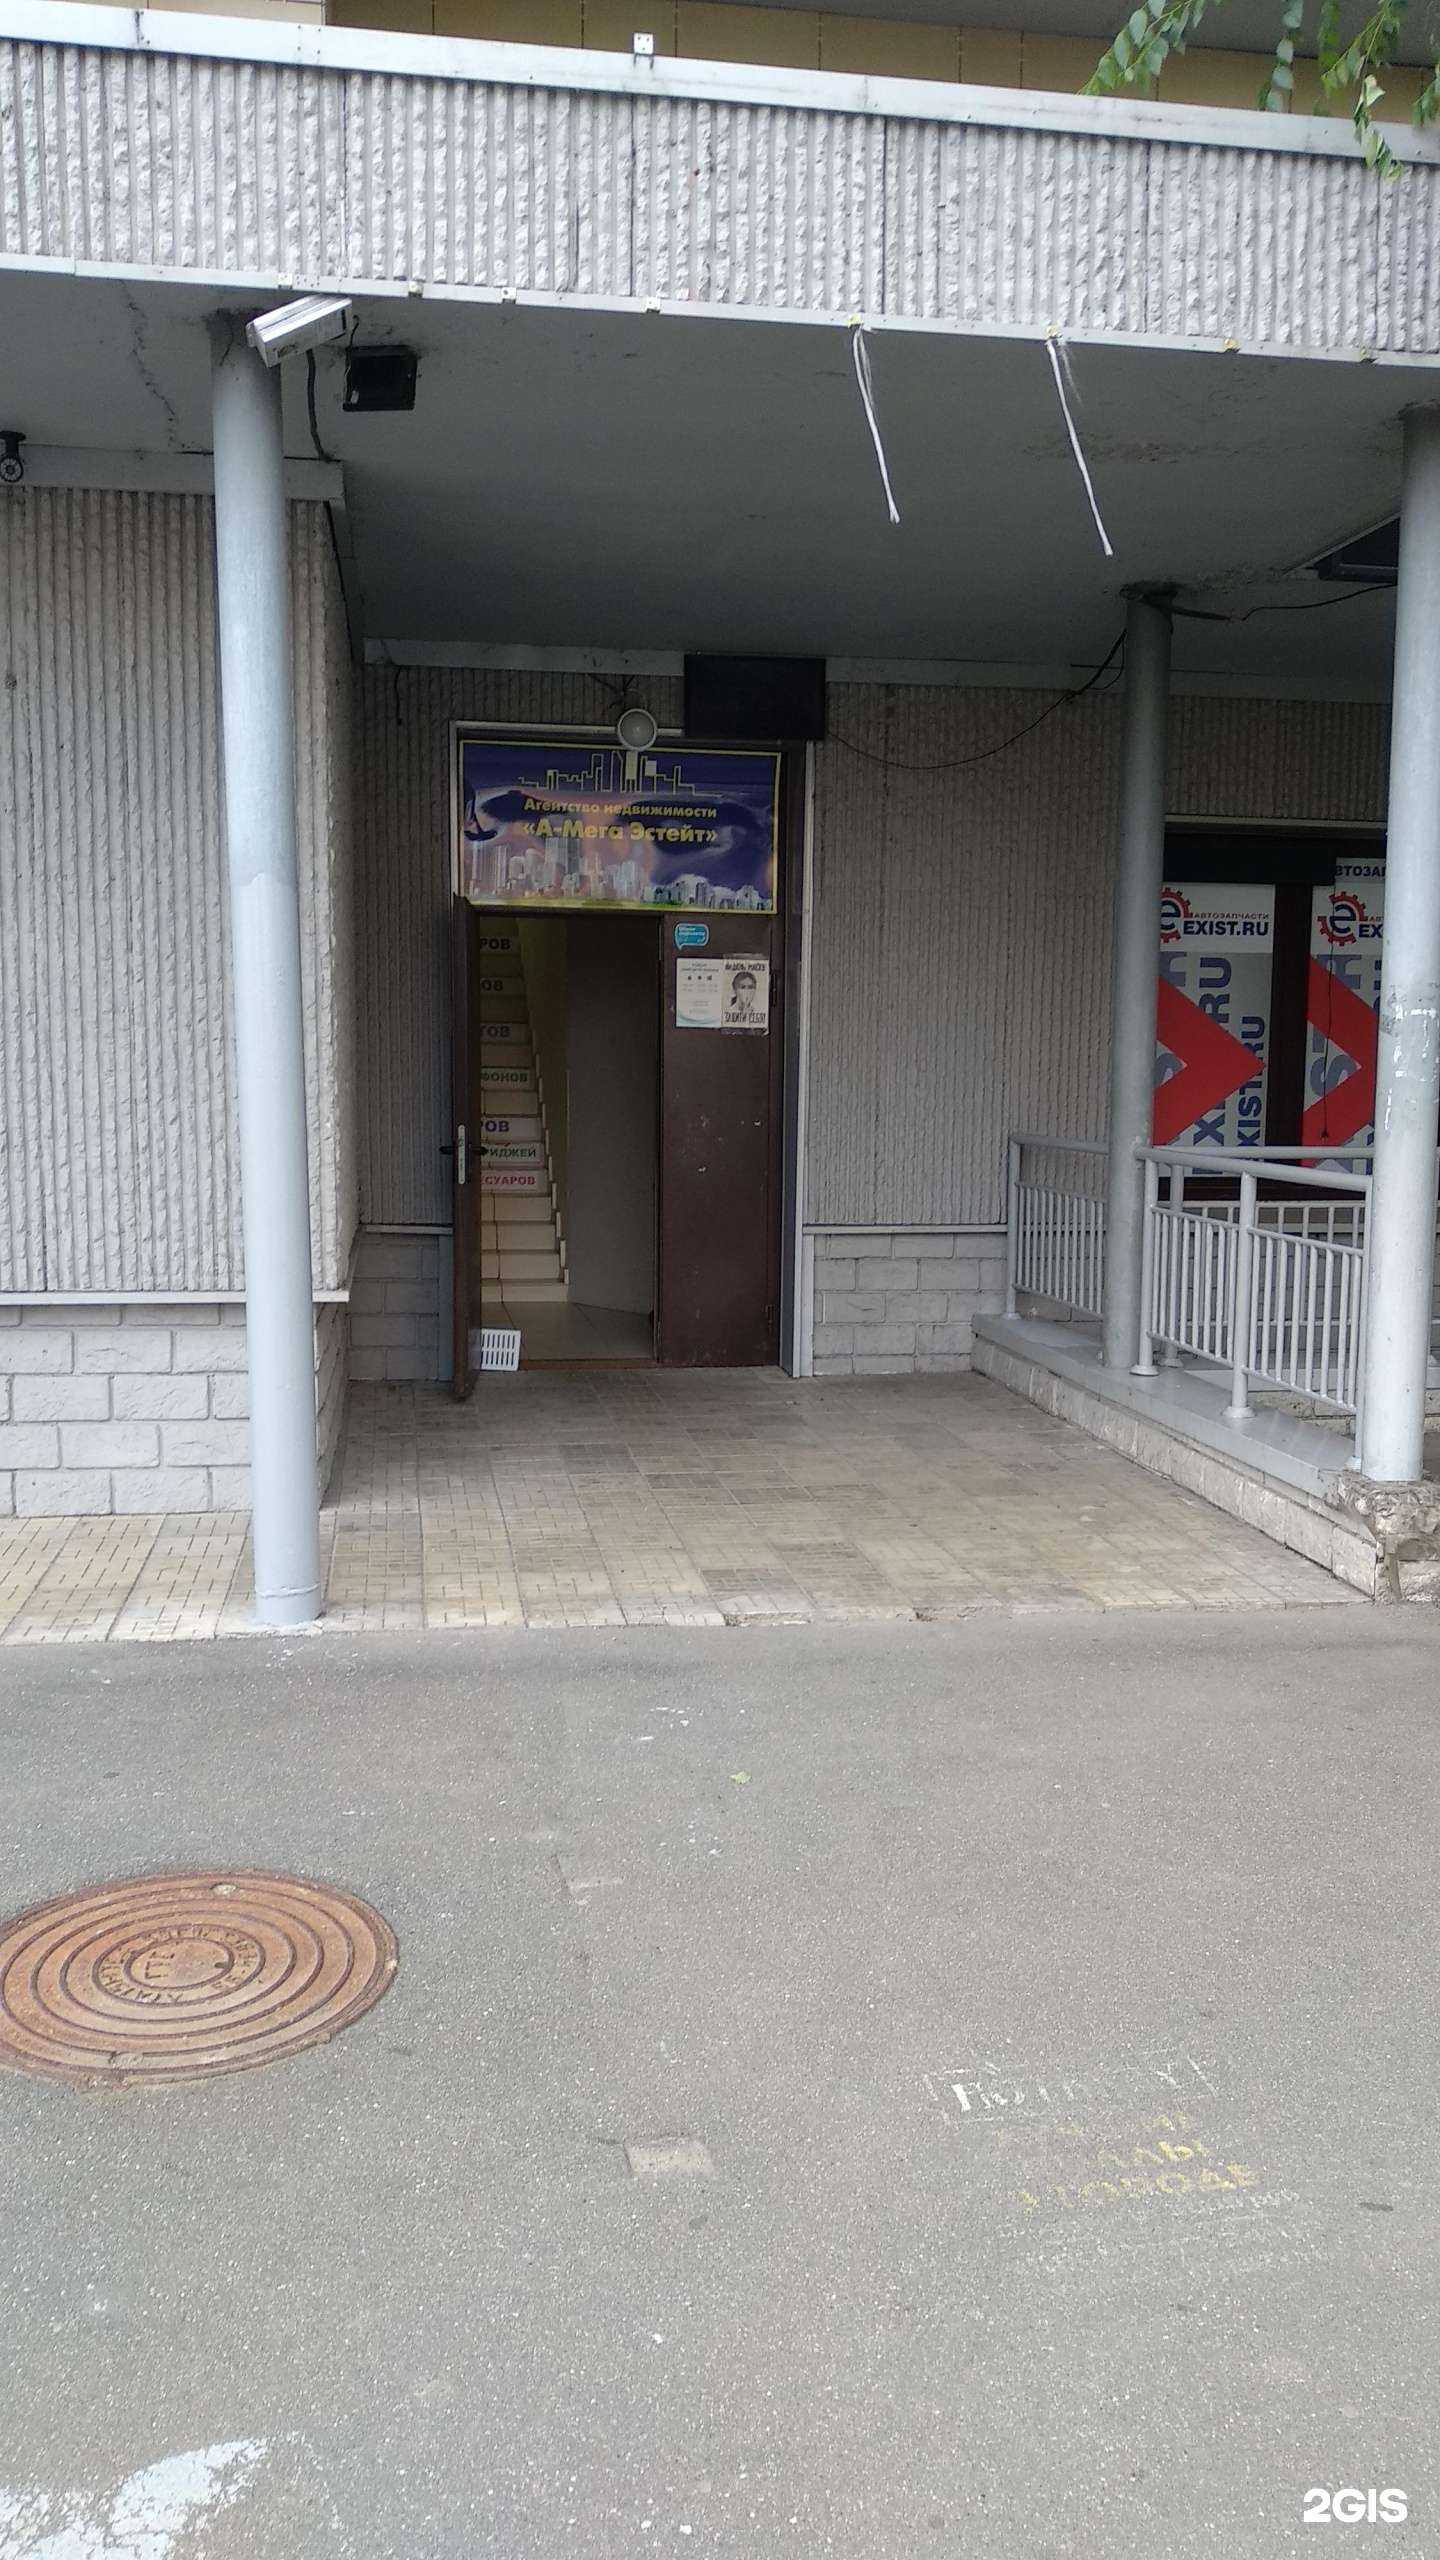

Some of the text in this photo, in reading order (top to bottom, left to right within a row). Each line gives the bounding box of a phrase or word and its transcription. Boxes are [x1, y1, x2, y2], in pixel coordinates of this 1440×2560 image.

[523, 798, 717, 819] Агентство недвижимости
[522, 817, 718, 843] «А-Мега Эстейт»
[1194, 912, 1270, 921] АВТОЗАПЧАСТИ
[1183, 920, 1269, 936] EXIST.RU
